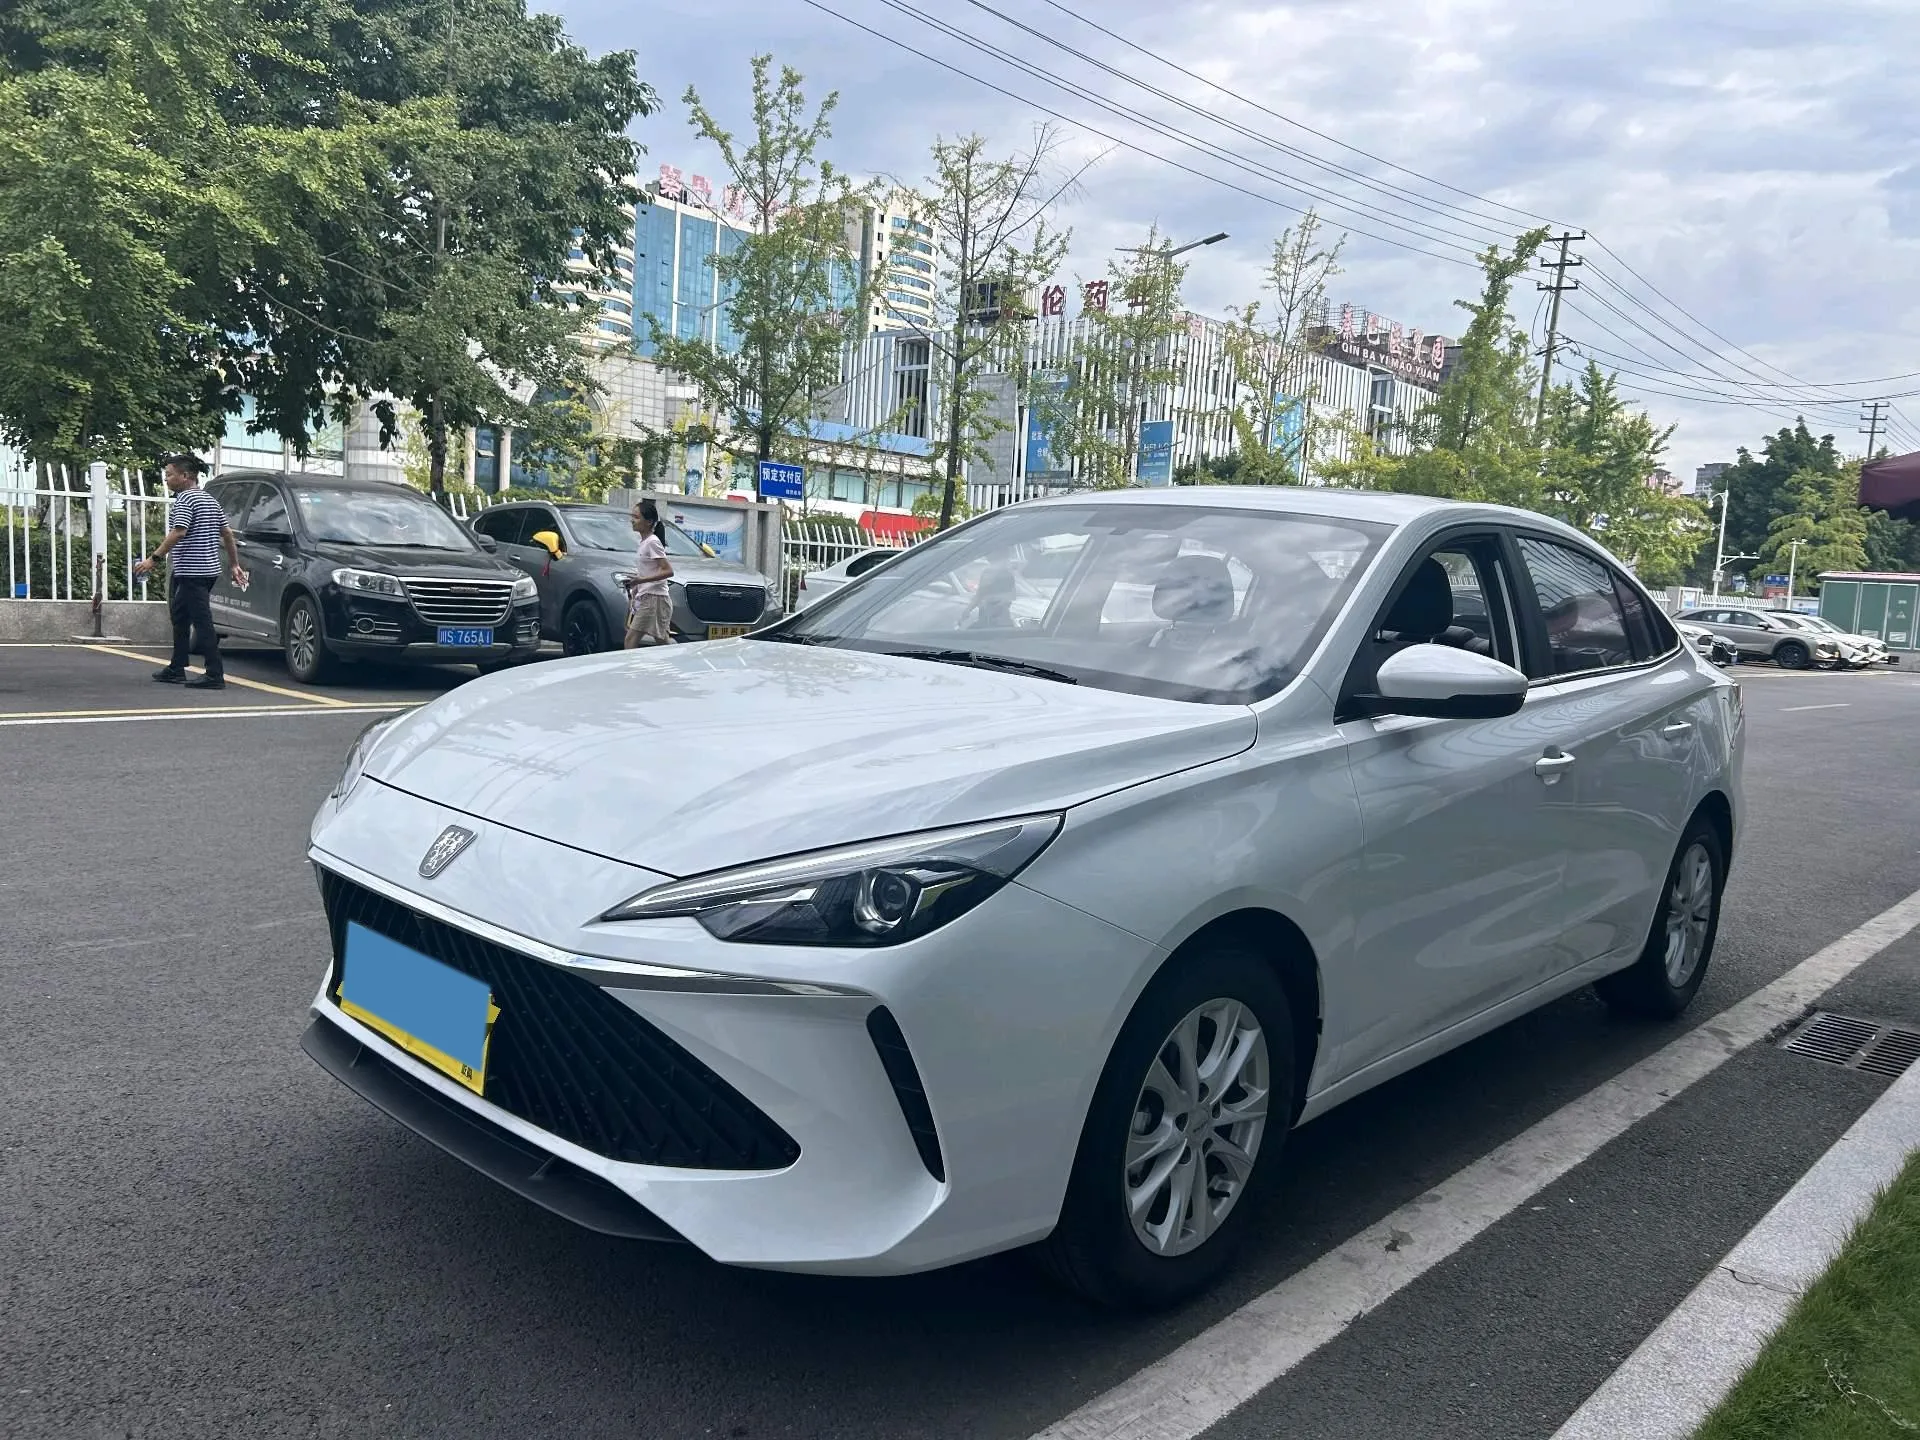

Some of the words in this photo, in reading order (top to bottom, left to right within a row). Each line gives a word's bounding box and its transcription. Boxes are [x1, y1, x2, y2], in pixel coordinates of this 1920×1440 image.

[1341, 342, 1360, 357] QIN
[1362, 348, 1376, 361] BA
[1379, 354, 1389, 365] YI
[1391, 357, 1412, 373] MAO
[1415, 366, 1440, 382] YUAN
[762, 467, 802, 485] 预定交付区
